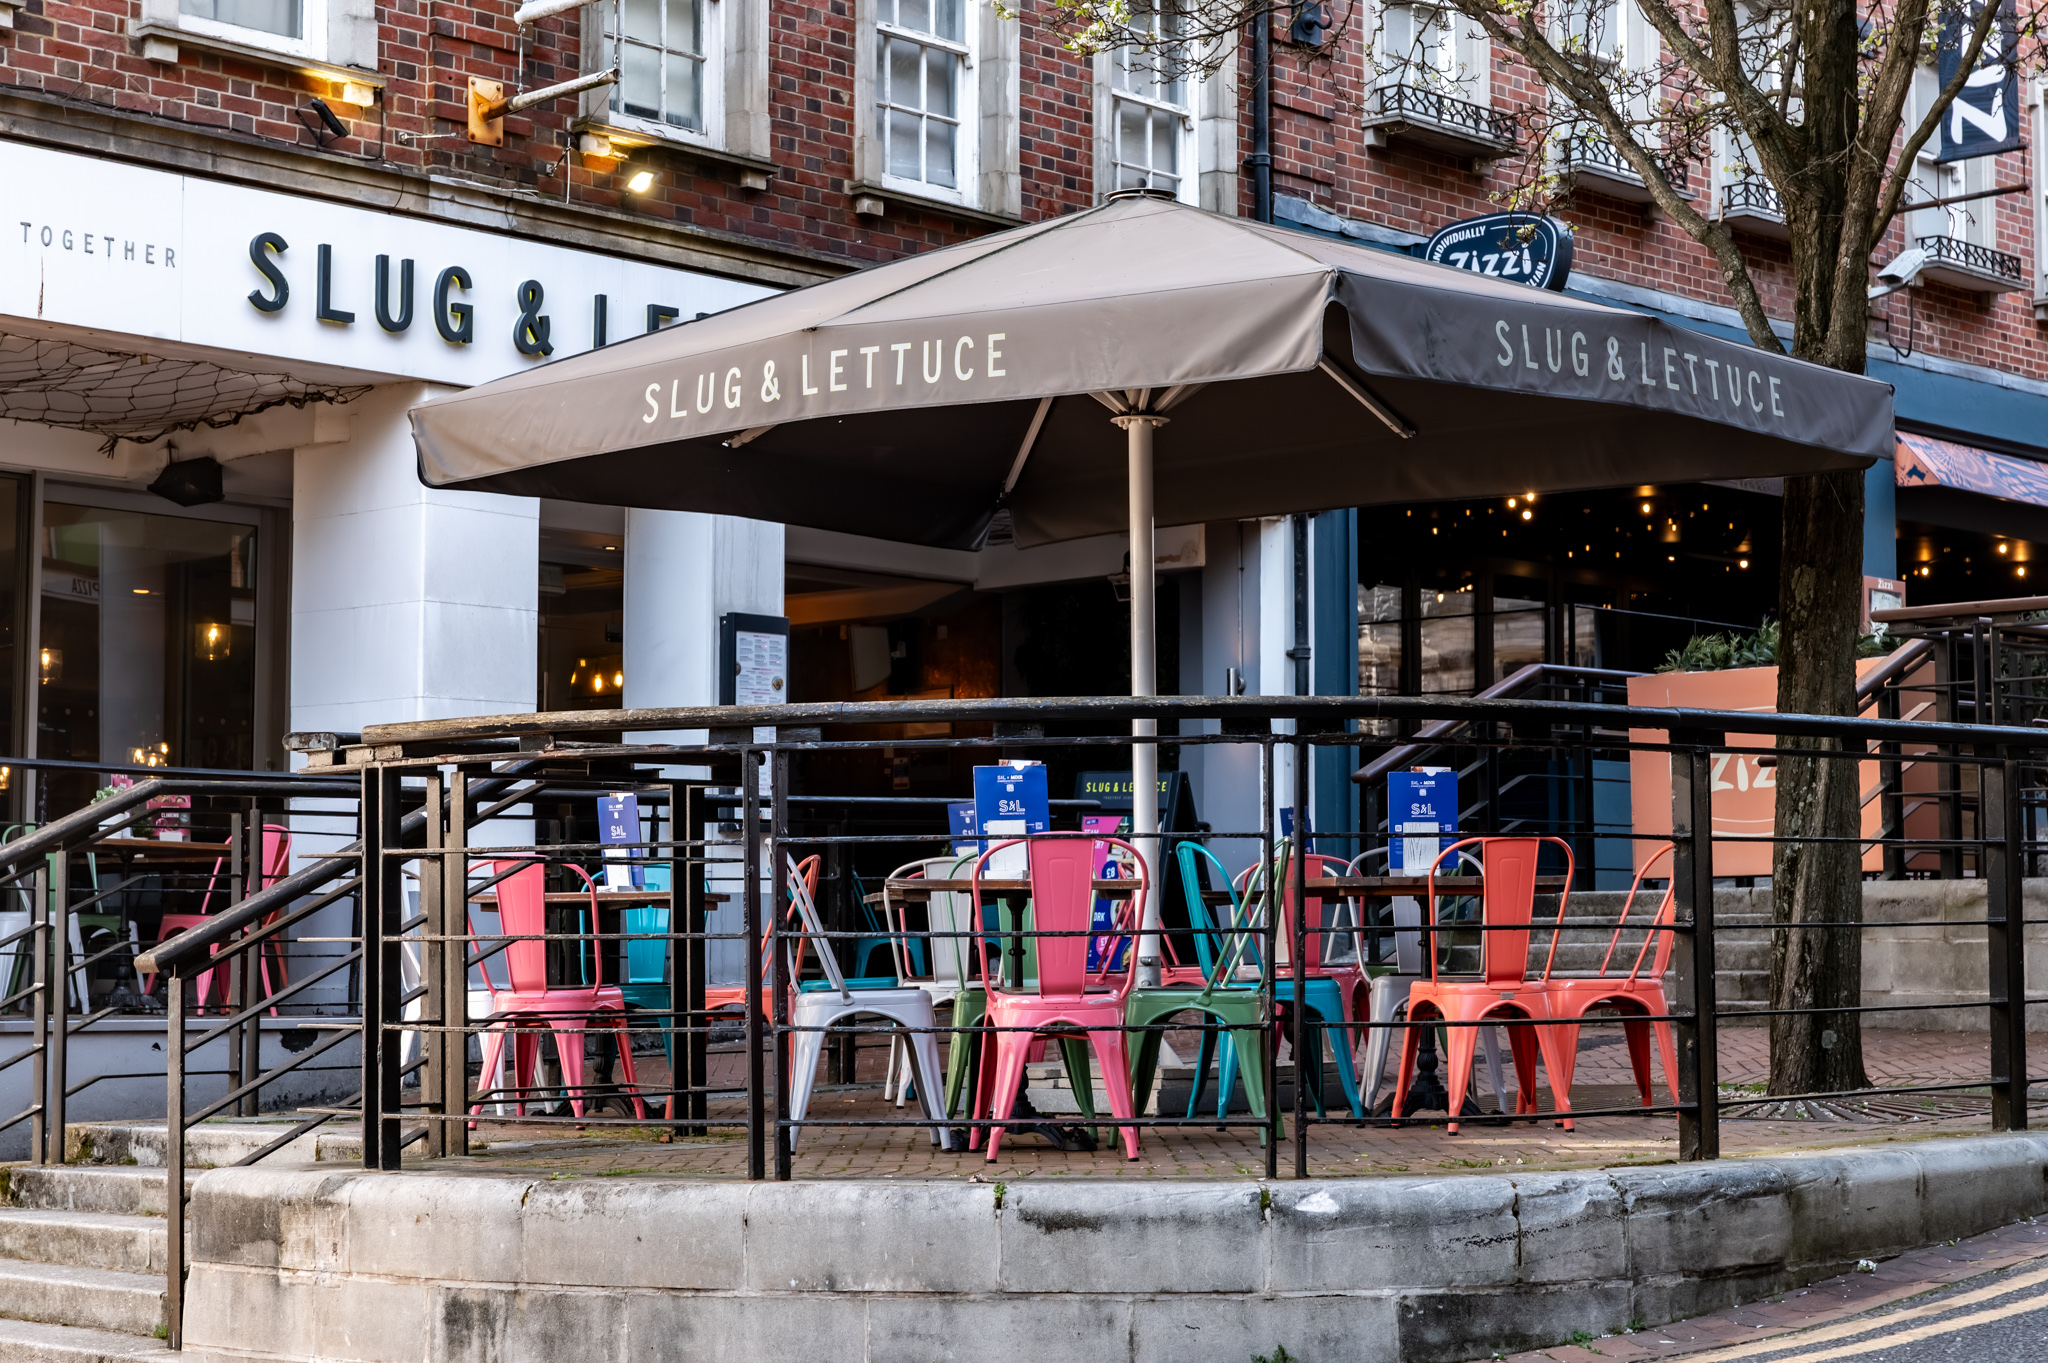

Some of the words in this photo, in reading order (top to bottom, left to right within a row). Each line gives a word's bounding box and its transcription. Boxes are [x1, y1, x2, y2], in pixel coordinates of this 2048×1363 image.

[20, 221, 176, 268] TOGETHER
[1432, 225, 1486, 264] INDIVIDUALLY
[248, 231, 474, 345] SLUG
[513, 279, 554, 356] &
[642, 366, 742, 424] SLUG
[760, 359, 781, 402] &
[801, 332, 1007, 396] LETTUCE
[1495, 319, 1589, 377] SLUG
[1607, 336, 1625, 381] &
[1640, 341, 1785, 417] LETTUCE
[999, 799, 1026, 813] S&L
[1086, 782, 1110, 792] SLUG
[1113, 782, 1119, 792] &
[1411, 803, 1436, 815] S&L
[1106, 867, 1116, 879] £8
